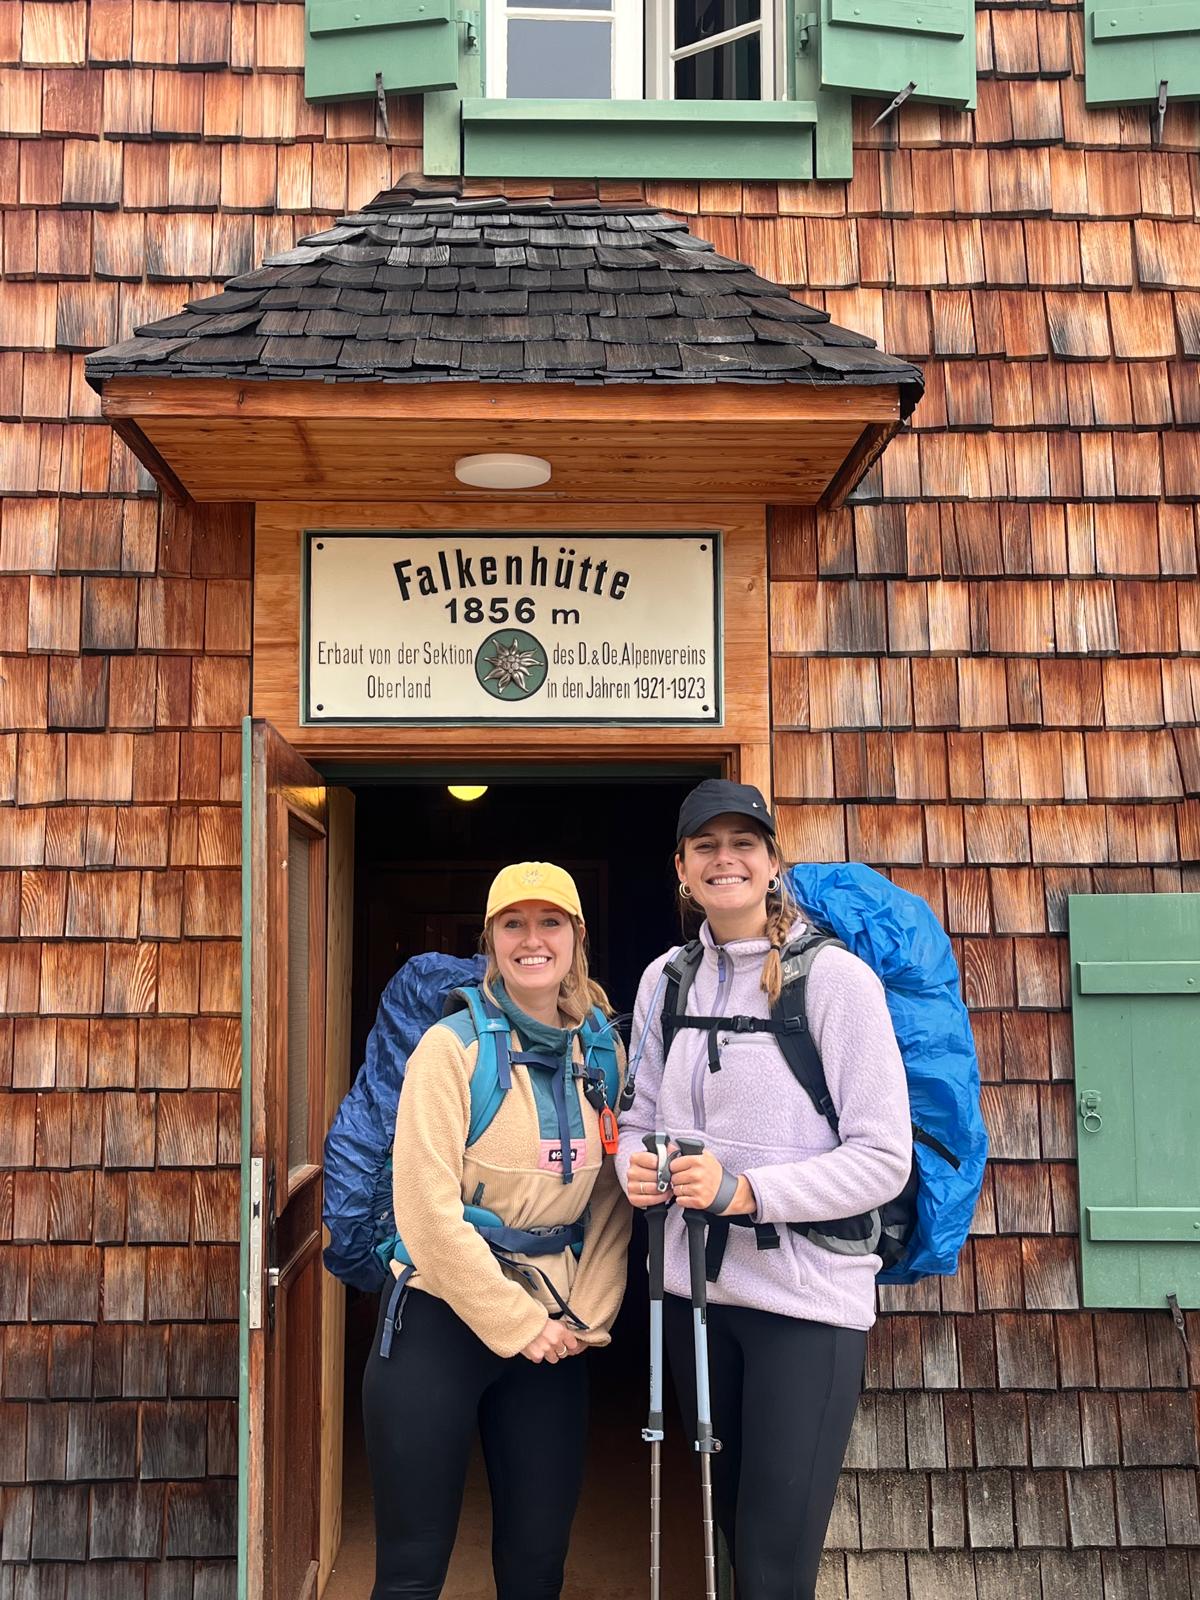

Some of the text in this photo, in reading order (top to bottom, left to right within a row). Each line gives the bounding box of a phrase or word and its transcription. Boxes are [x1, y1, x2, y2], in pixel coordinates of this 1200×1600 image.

[392, 545, 631, 602] Falkenhütte
[444, 596, 580, 625] 1856 m
[318, 641, 474, 665] Erbaut von der Sektion
[553, 642, 575, 665] des
[366, 674, 432, 699] Oberland
[547, 675, 706, 700] in den Jahren 1921-1923
